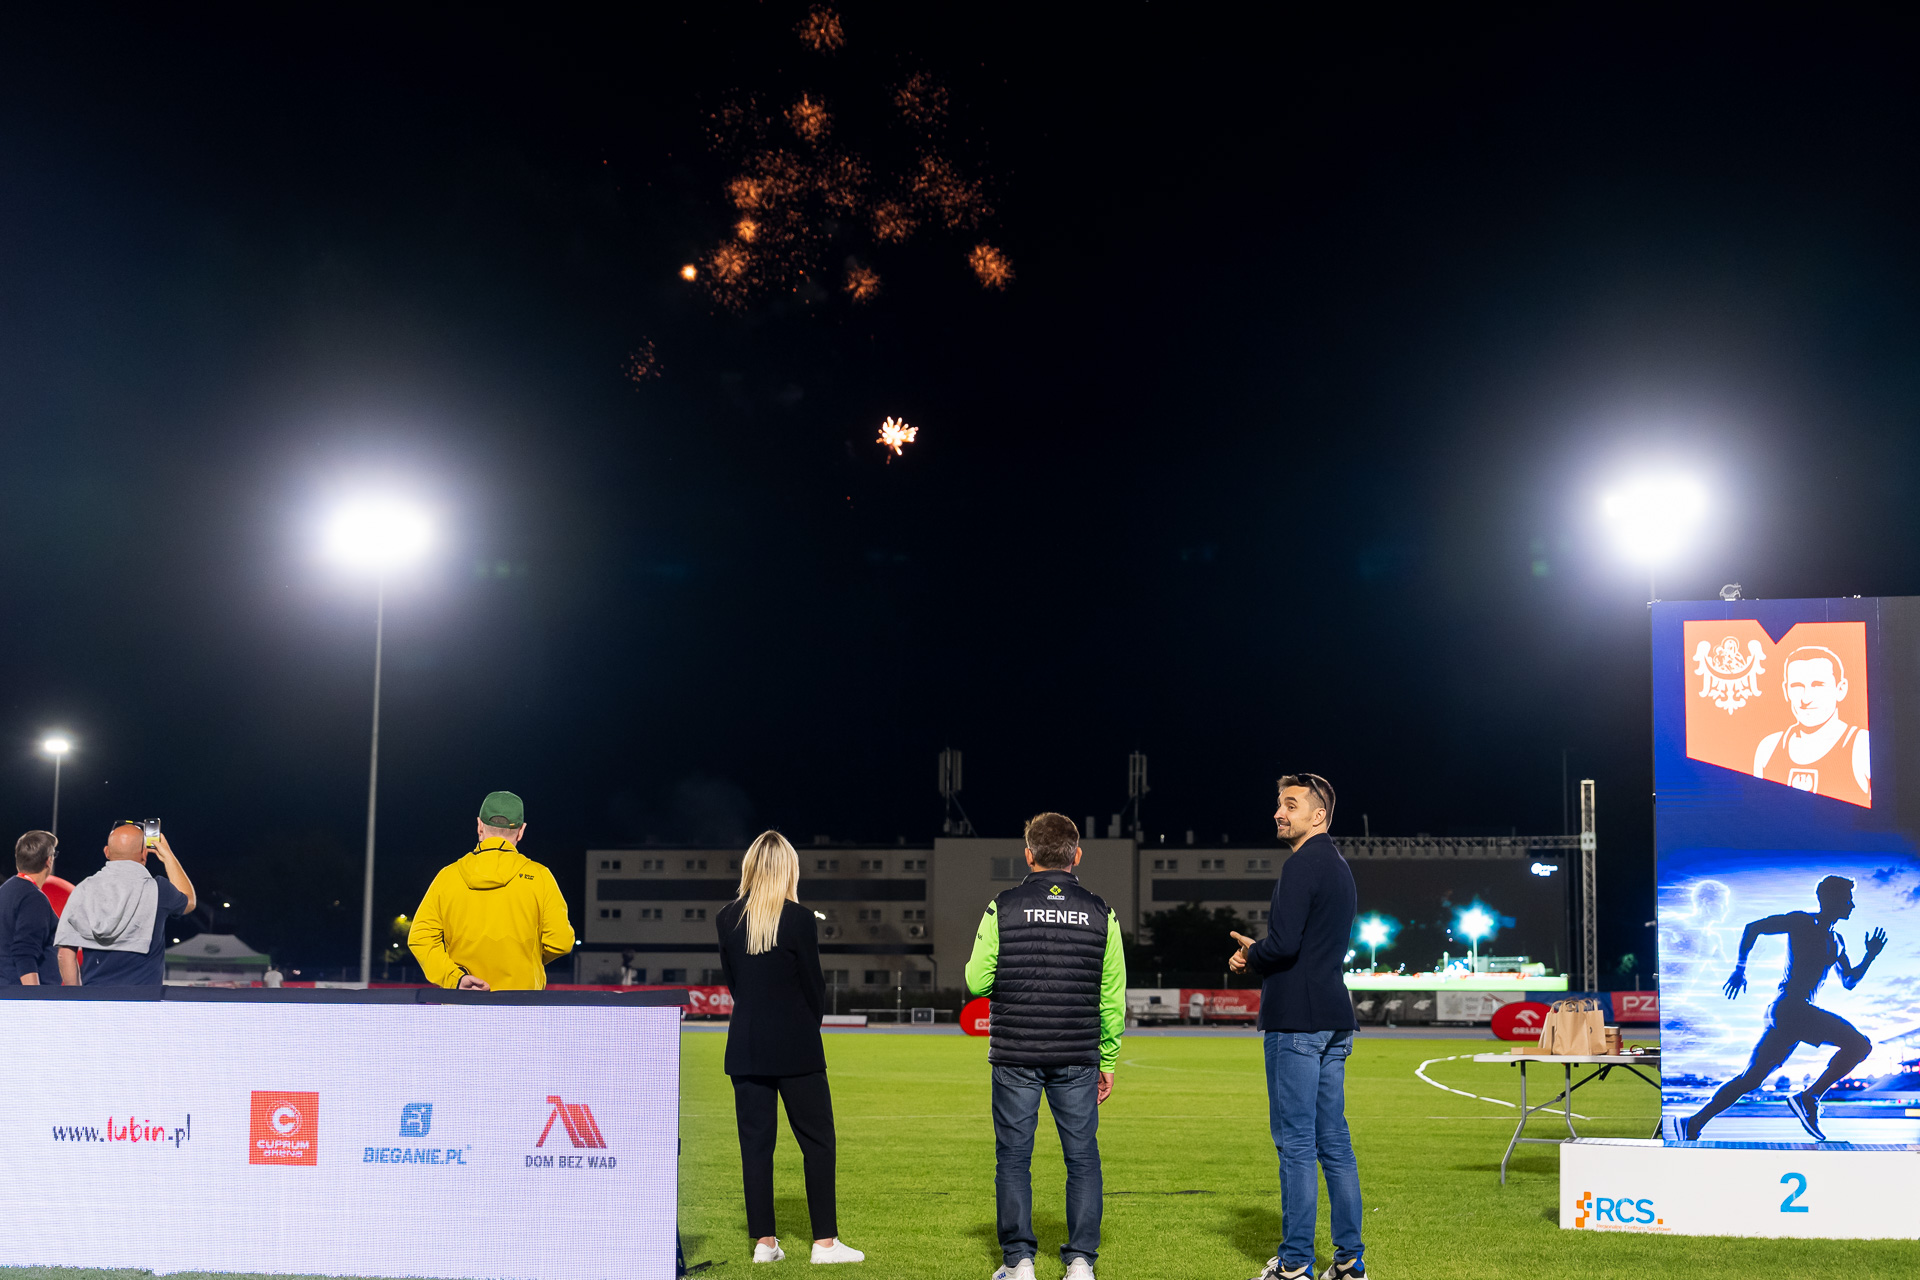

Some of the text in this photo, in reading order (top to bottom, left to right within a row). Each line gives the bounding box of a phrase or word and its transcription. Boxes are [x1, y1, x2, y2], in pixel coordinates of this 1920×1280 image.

[1023, 909, 1090, 926] TRENER
[52, 1113, 191, 1149] www.lubin.pl
[256, 1139, 310, 1150] CUPRUM
[525, 1154, 617, 1170] DOM BEZ WAD
[1780, 1171, 1810, 1213] 2
